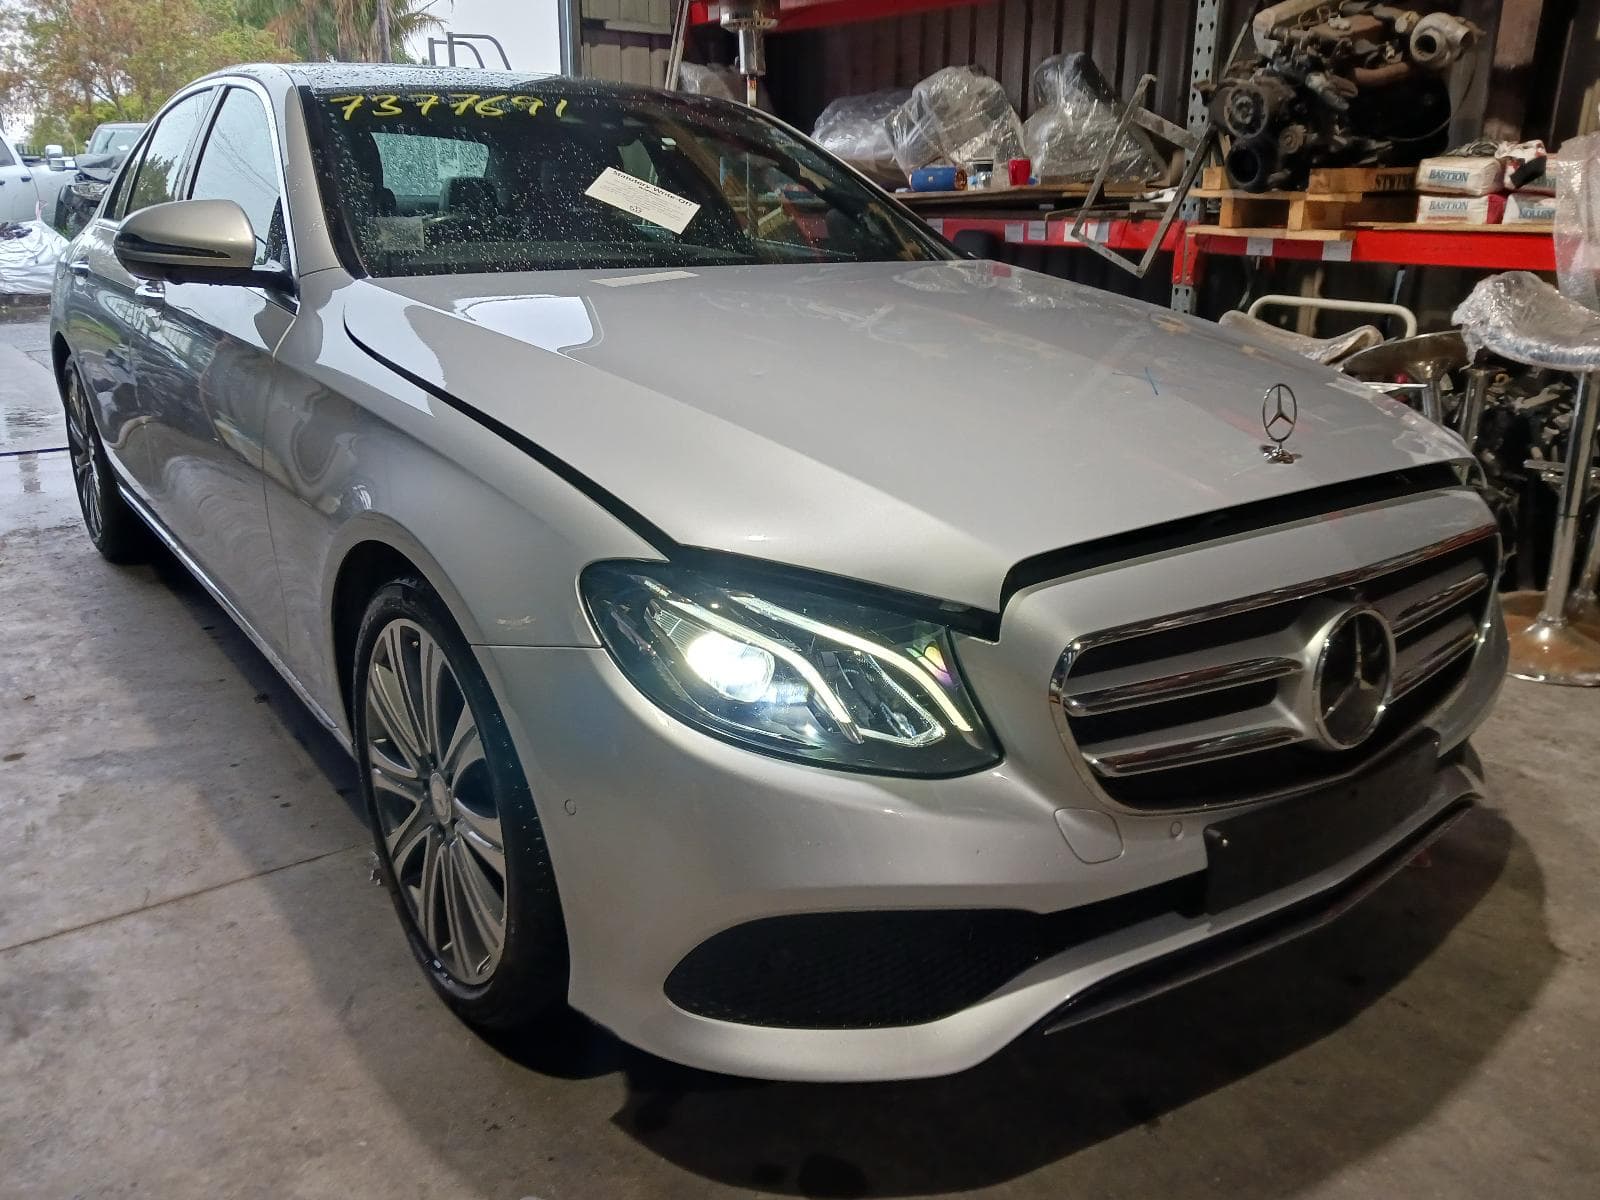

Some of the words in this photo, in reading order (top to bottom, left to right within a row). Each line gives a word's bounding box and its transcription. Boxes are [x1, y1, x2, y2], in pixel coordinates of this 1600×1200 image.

[330, 93, 568, 120] 7377691
[612, 170, 651, 189] Statutory
[1428, 170, 1470, 183] BASTION
[1428, 200, 1469, 212] BASTION
